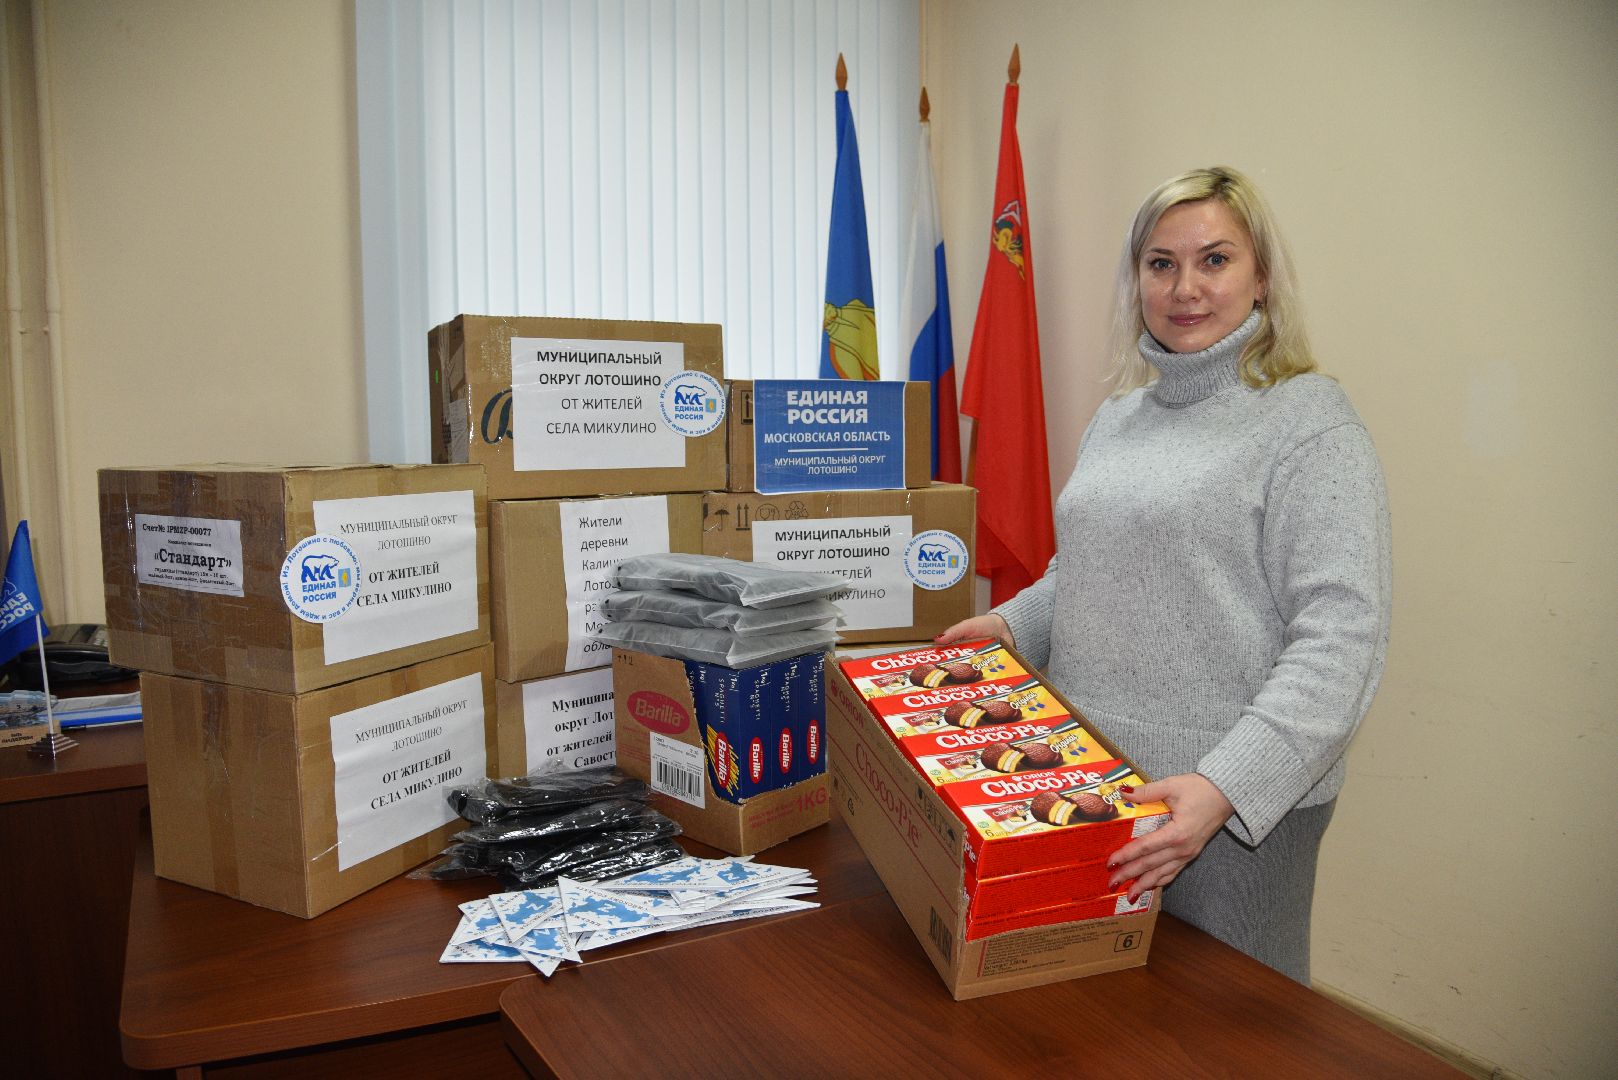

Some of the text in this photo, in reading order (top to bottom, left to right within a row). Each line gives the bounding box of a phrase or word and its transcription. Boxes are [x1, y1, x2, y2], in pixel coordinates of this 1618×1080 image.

[537, 351, 662, 365] МУНИЦИПАЛЬНЫЙ
[540, 373, 661, 386] ОКРУГ ЛОТОШИНО
[562, 396, 642, 410] ОТ ЖИТЕЛЕЙ
[787, 390, 868, 406] ЕДИНАЯ
[788, 409, 868, 424] РОССИЯ
[546, 422, 656, 434] СЕЛА МИКУЛИНО
[764, 431, 890, 444] МОСКОВСКАЯ ОБЛАСТЬ
[774, 454, 886, 466] МУНИЦИПАЛЬНЫЙ ОКРУГ
[808, 466, 858, 475] ЛОТОШИНО
[340, 515, 458, 534] МУНИЦИПАЛЬНЫЙ ОКРУГ
[579, 516, 622, 528] Жители
[775, 525, 890, 541] МУНИЦИПАЛЬНЫЙ
[287, 538, 320, 564] Лотошино
[329, 538, 358, 564] любовью:
[378, 536, 430, 550] ЛОТОШИНО
[580, 536, 628, 552] деревни
[154, 548, 232, 571] «Стандарт»
[777, 546, 890, 560] ОКРУГ ЛОТОШИНО
[282, 566, 290, 578] Из
[356, 566, 360, 580] мы
[369, 562, 440, 583] ОТ ЖИТЕЛЕЙ
[302, 581, 336, 592] ЕДИНАЯ
[584, 580, 613, 592] Лото
[282, 582, 300, 610] домой!
[303, 592, 336, 603] РОССИЯ
[346, 583, 360, 608] верим
[357, 582, 452, 607] СЕЛА МИКУЛИНО
[329, 611, 340, 619] вас
[906, 649, 936, 658] ORION
[972, 653, 1000, 671] Original
[939, 686, 970, 694] ORION
[552, 692, 614, 712] Муниципа
[1010, 690, 1038, 710] Original
[636, 698, 682, 728] Barilla
[355, 700, 468, 743] МУНИЦИПАЛЬНЫЙ ОКРУГ
[555, 712, 614, 732] округ Лот
[974, 725, 1007, 734] ORION
[392, 726, 442, 751] ЛОТОШИНО
[546, 746, 560, 756] от
[563, 731, 612, 752] жителей
[1050, 734, 1078, 752] Original
[574, 750, 616, 768] Савост
[782, 734, 790, 768] Barilla
[382, 749, 450, 784] ОТ ЖИТЕЛЕЙ
[718, 738, 726, 783] Barilla
[752, 744, 760, 778] Barilla
[1021, 770, 1056, 780] ORION
[371, 766, 462, 810] СЕЛА МИКУЛИНО
[1122, 935, 1134, 948] 6
